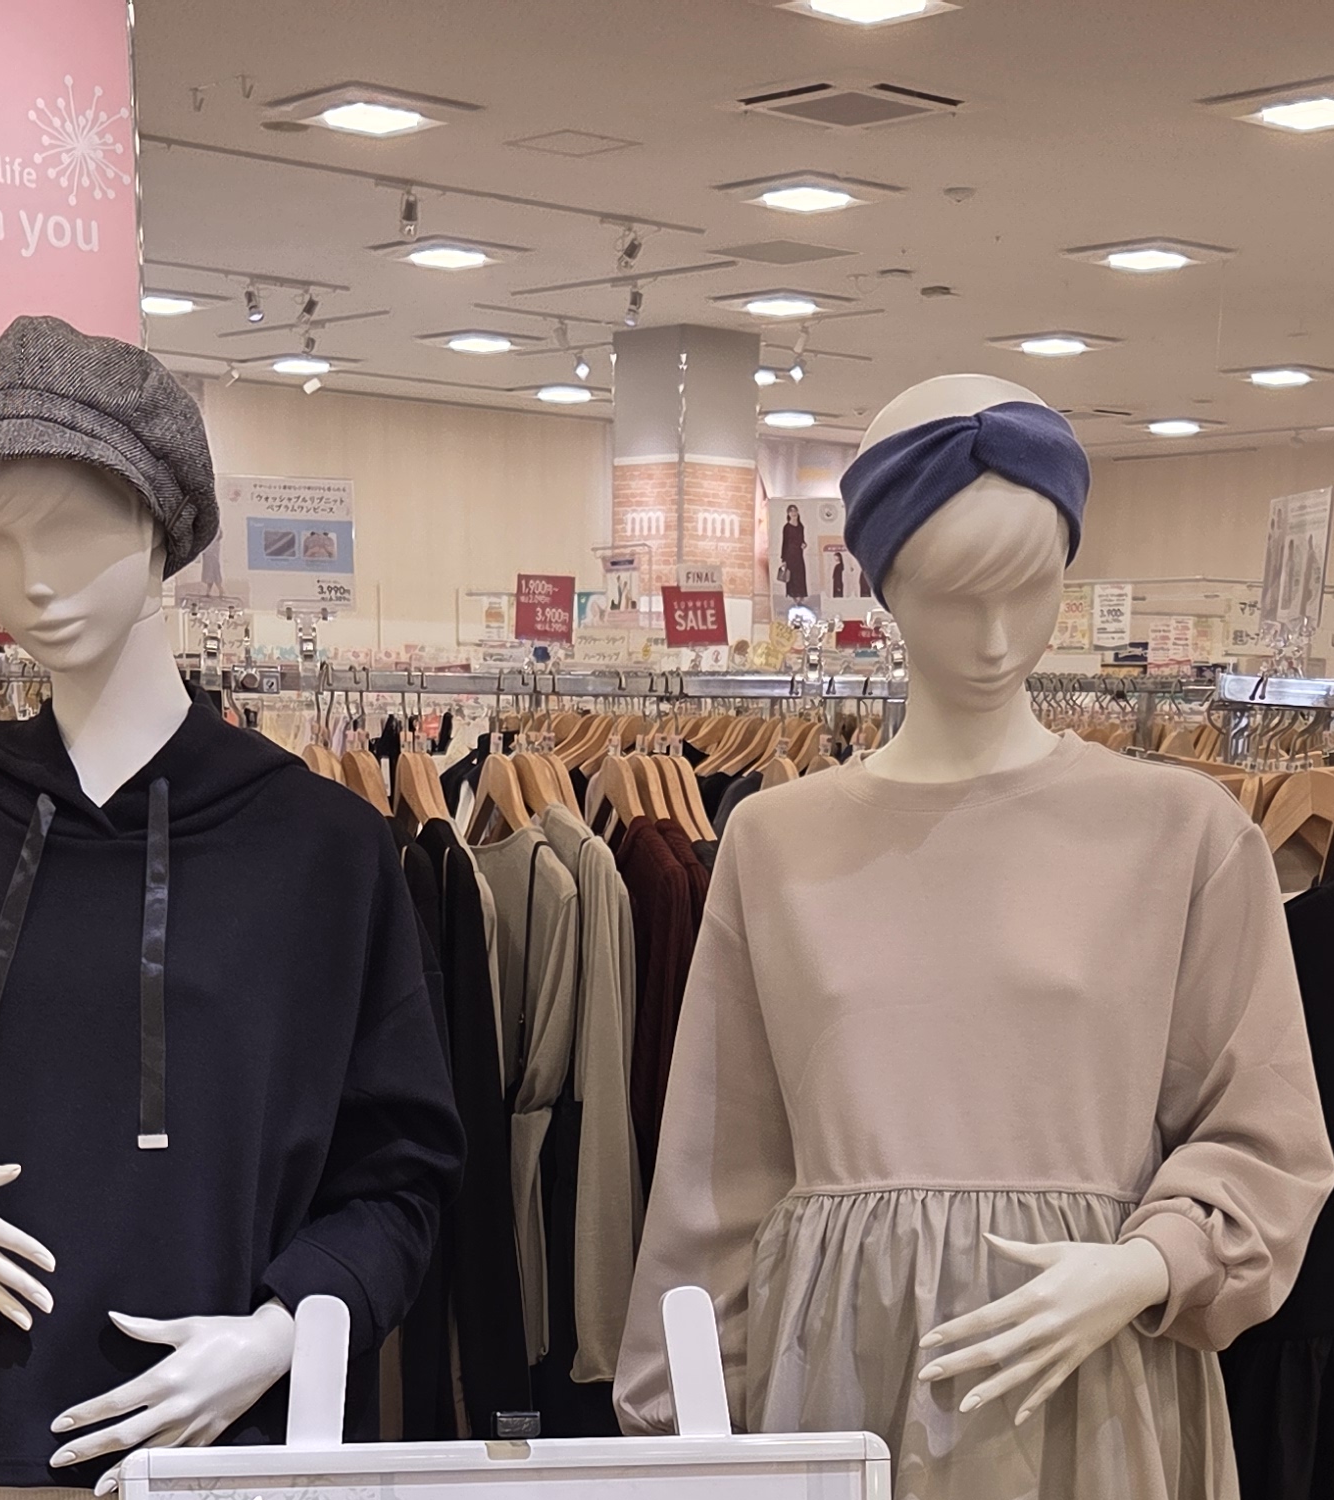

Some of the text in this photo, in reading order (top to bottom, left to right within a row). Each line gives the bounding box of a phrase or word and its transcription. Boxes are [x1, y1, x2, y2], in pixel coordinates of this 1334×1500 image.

[19, 208, 100, 258] you
[685, 571, 717, 584] FINAL
[535, 607, 570, 623] 3,900円
[673, 609, 718, 632] SALE
